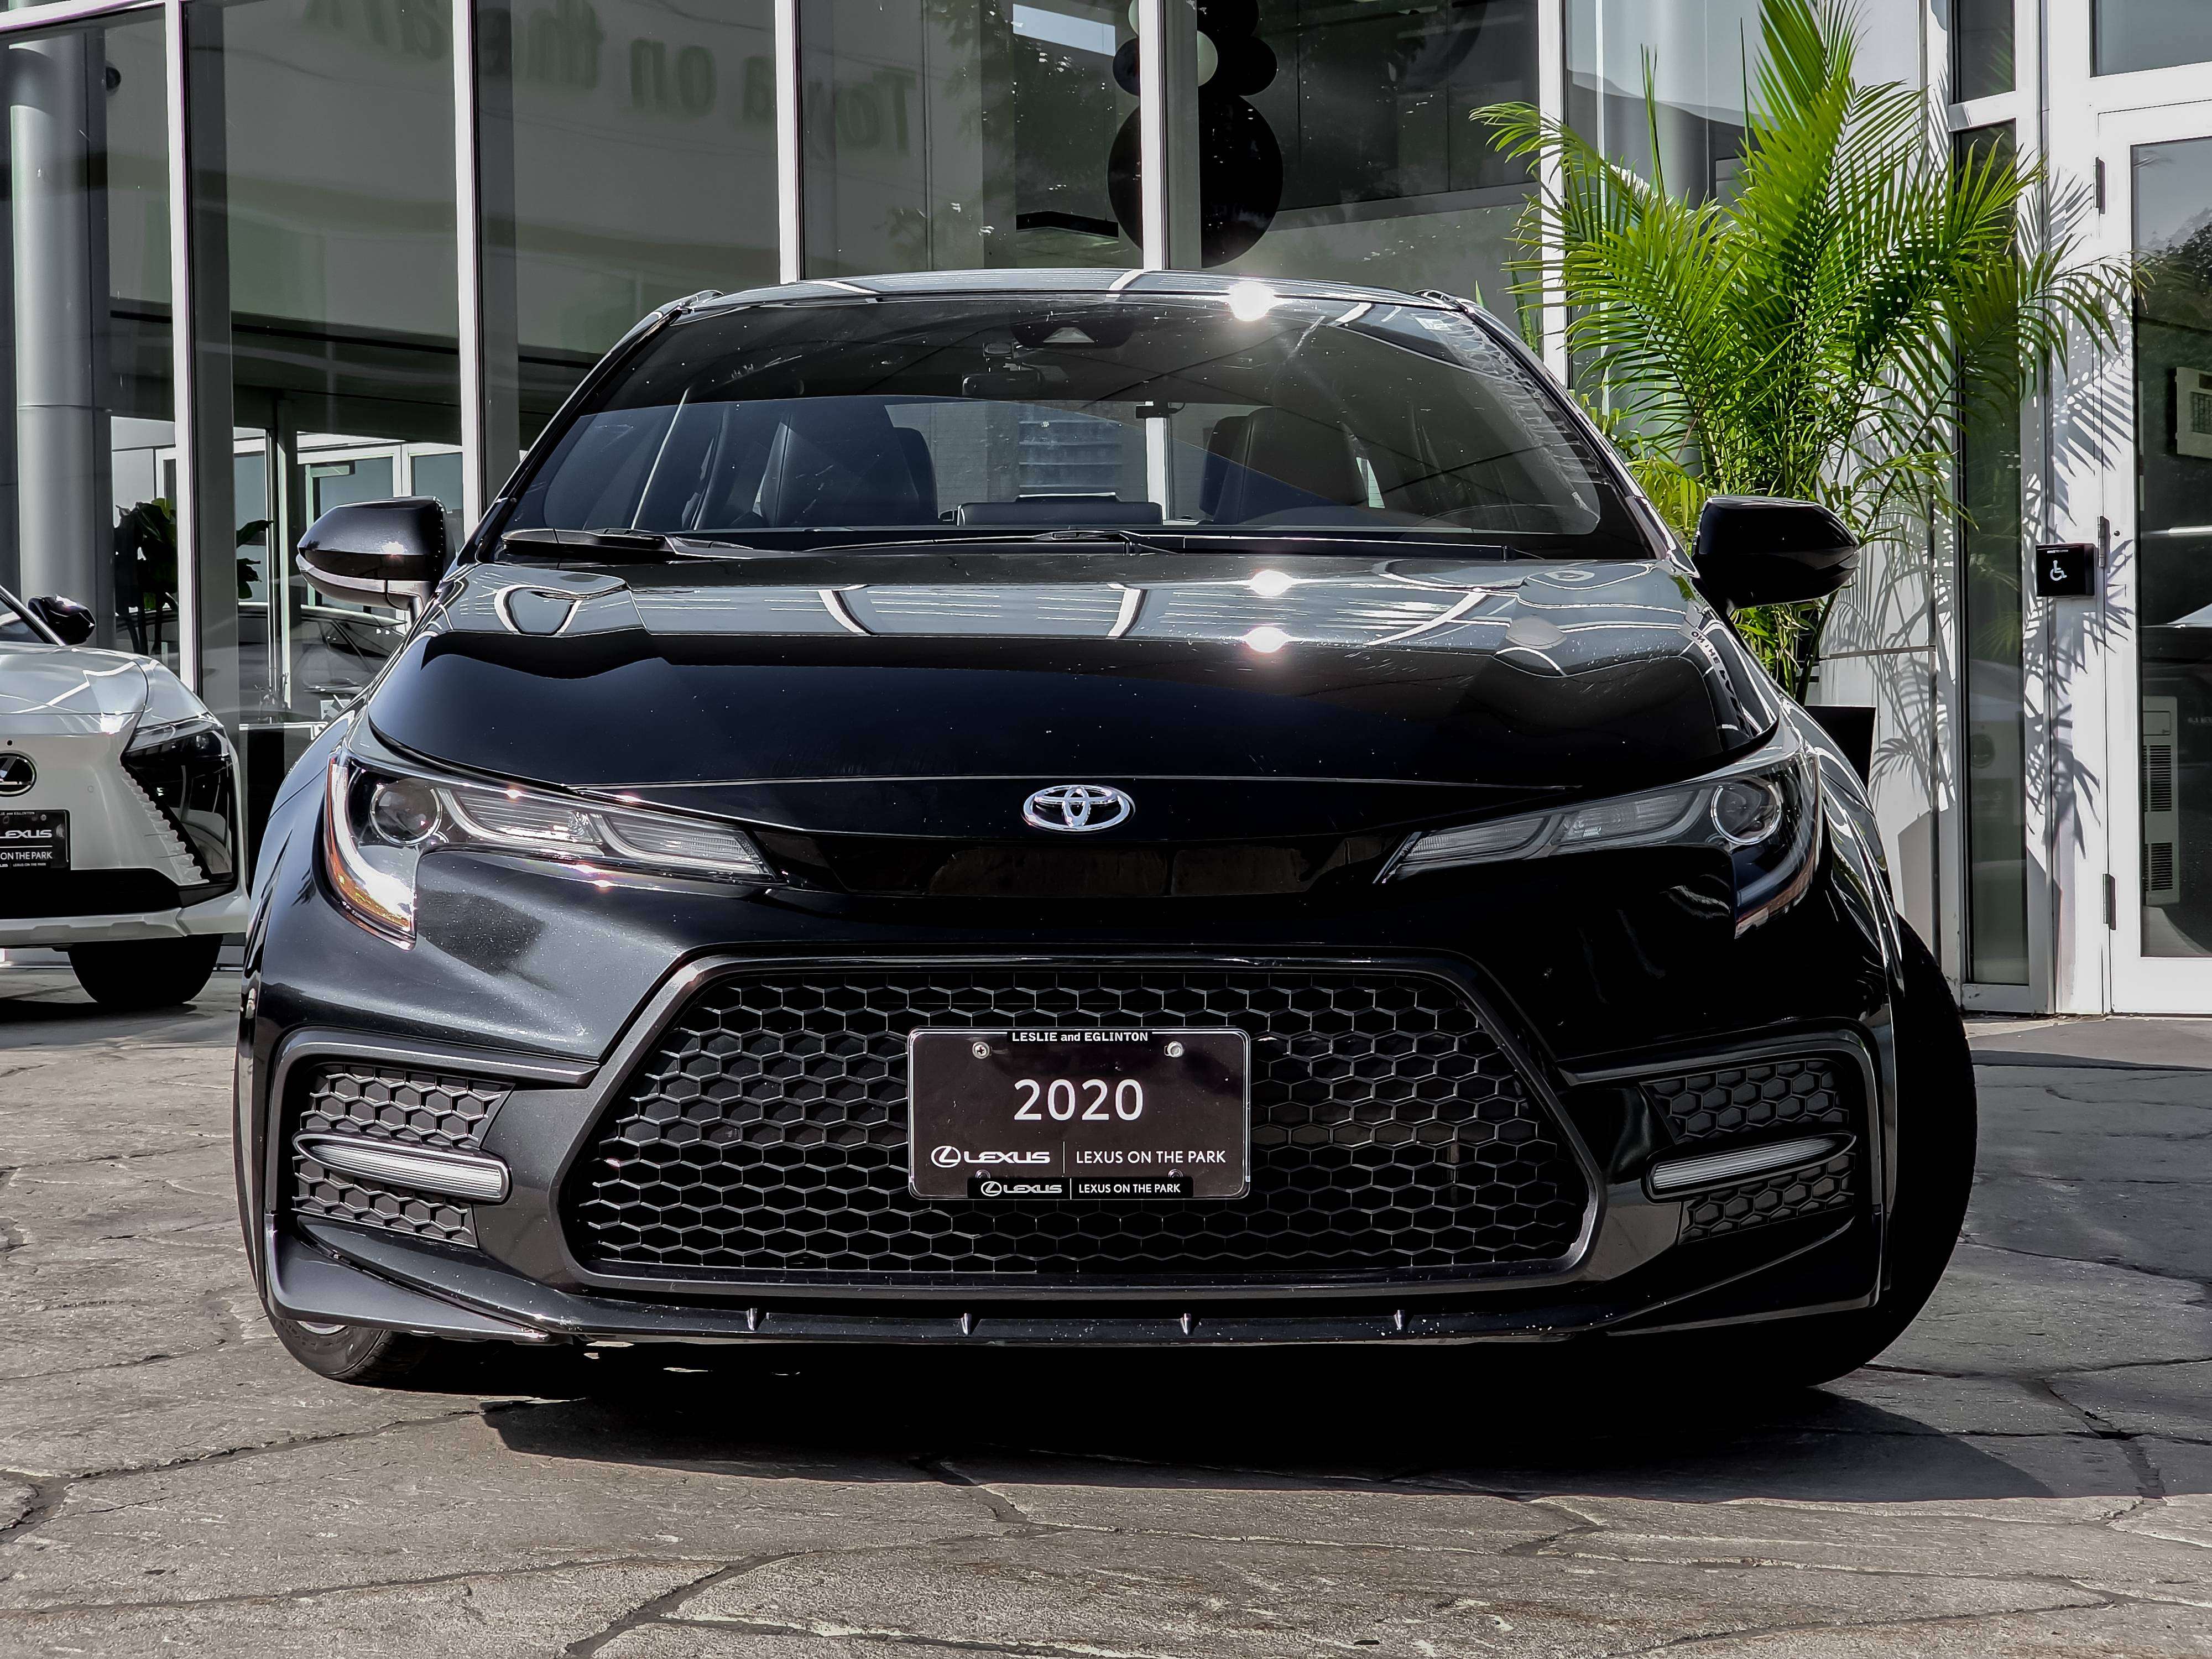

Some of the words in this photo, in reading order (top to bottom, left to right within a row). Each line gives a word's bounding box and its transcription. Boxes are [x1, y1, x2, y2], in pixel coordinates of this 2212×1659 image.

[15, 852, 30, 860] THE
[31, 851, 53, 859] PARK
[1012, 1032, 1057, 1042] LESLIE
[1061, 1032, 1081, 1042] and
[1084, 1032, 1148, 1042] EGLINTON
[1013, 1078, 1143, 1121] 2020
[964, 1151, 1051, 1164] LEXUS
[1076, 1151, 1123, 1164] LEXUS
[1127, 1151, 1151, 1164] ON
[1156, 1150, 1183, 1164] THE
[1188, 1150, 1227, 1164] PARK
[1003, 1185, 1062, 1193] LEXUS
[1079, 1184, 1111, 1193] LEXUS
[1113, 1183, 1130, 1193] ON
[1133, 1183, 1152, 1193] THE
[1154, 1183, 1181, 1193] PARK
